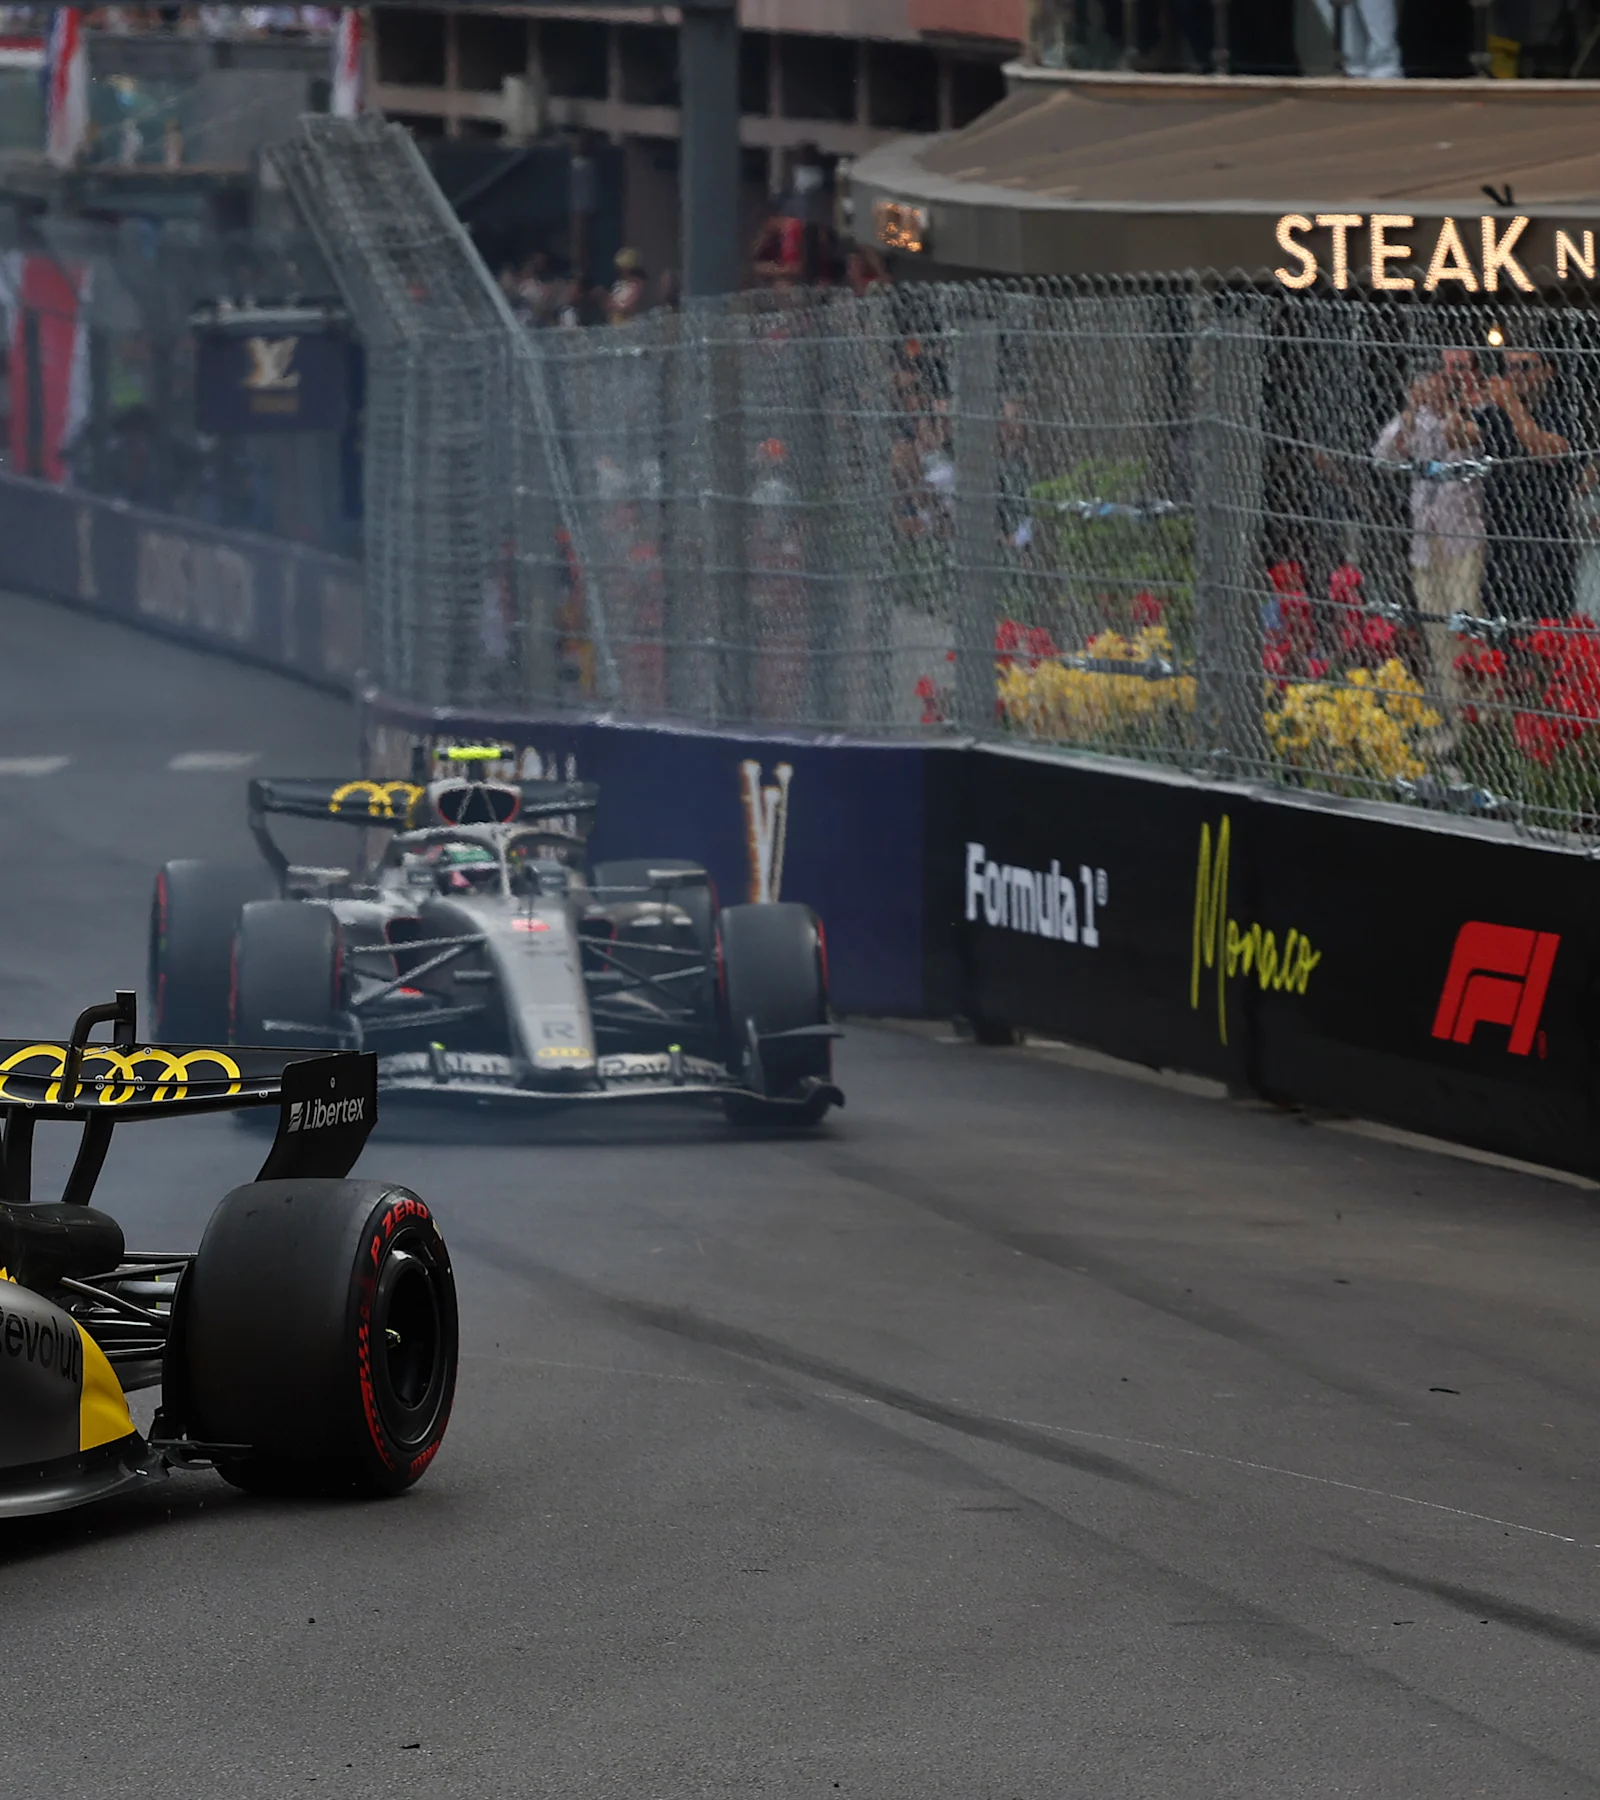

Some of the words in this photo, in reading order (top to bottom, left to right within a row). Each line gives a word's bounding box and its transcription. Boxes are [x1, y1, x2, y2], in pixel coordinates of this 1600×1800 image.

[1273, 213, 1536, 292] STEAK
[1556, 229, 1595, 279] N
[965, 841, 1078, 943] Formula
[1191, 813, 1322, 1046] Monaco
[303, 1096, 364, 1131] Libertex
[371, 1235, 381, 1267] P
[382, 1200, 429, 1239] ZERO
